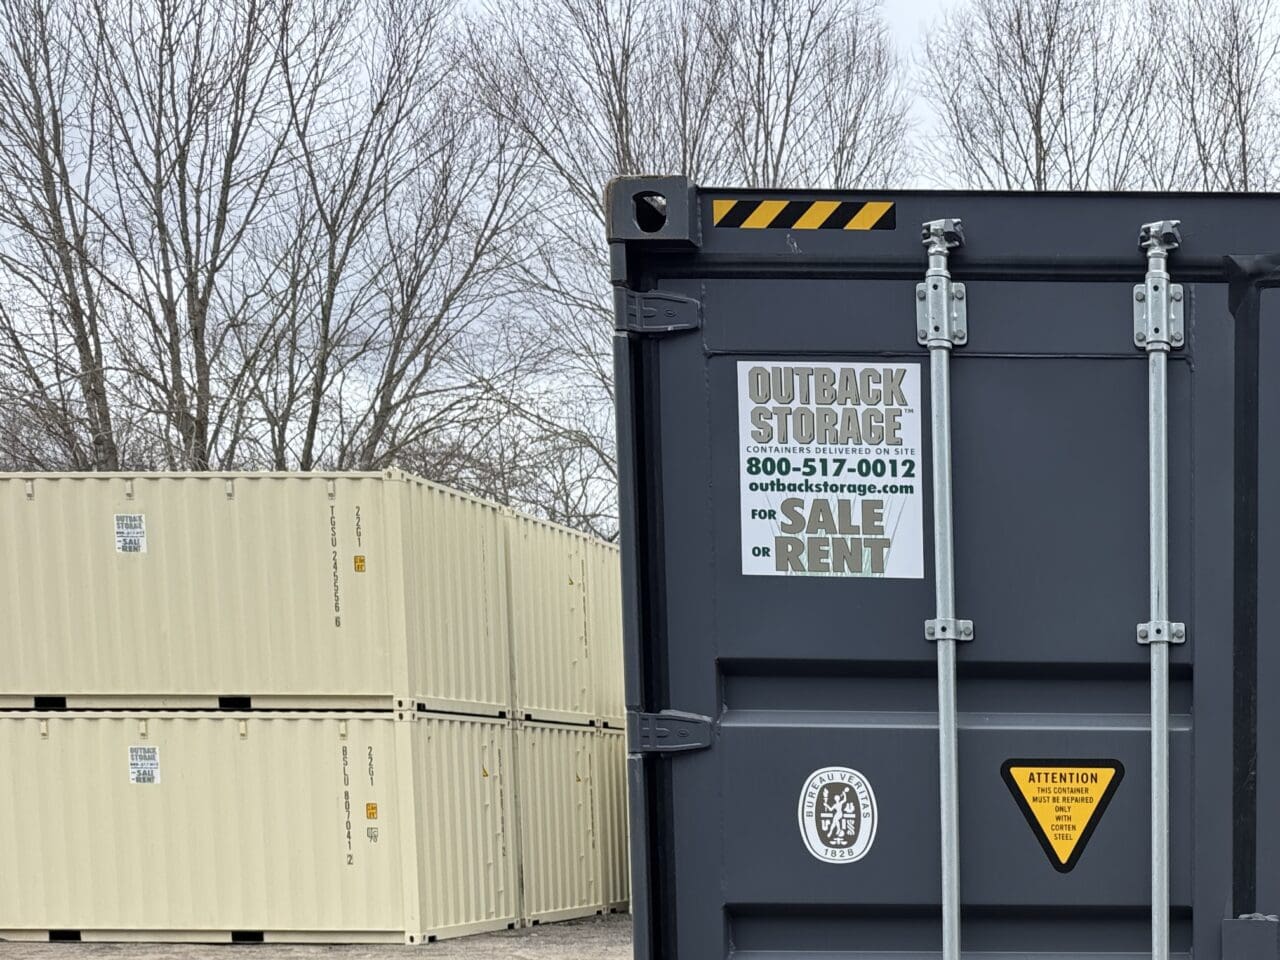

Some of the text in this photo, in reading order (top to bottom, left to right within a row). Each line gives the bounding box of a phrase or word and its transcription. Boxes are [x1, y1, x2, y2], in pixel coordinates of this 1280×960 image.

[748, 366, 908, 406] OUTBACK
[750, 406, 902, 446] STORAGE
[746, 446, 811, 454] CONTAINERS
[746, 457, 916, 478] 800-517-0012
[748, 479, 914, 496] outbackstorage.com
[751, 497, 884, 535] FOR SALE
[752, 536, 891, 573] OR RENT
[806, 773, 834, 817] BUREAU
[840, 773, 870, 818] VERITAS
[1028, 772, 1098, 783] ATTENTION
[824, 848, 854, 858] 1828
